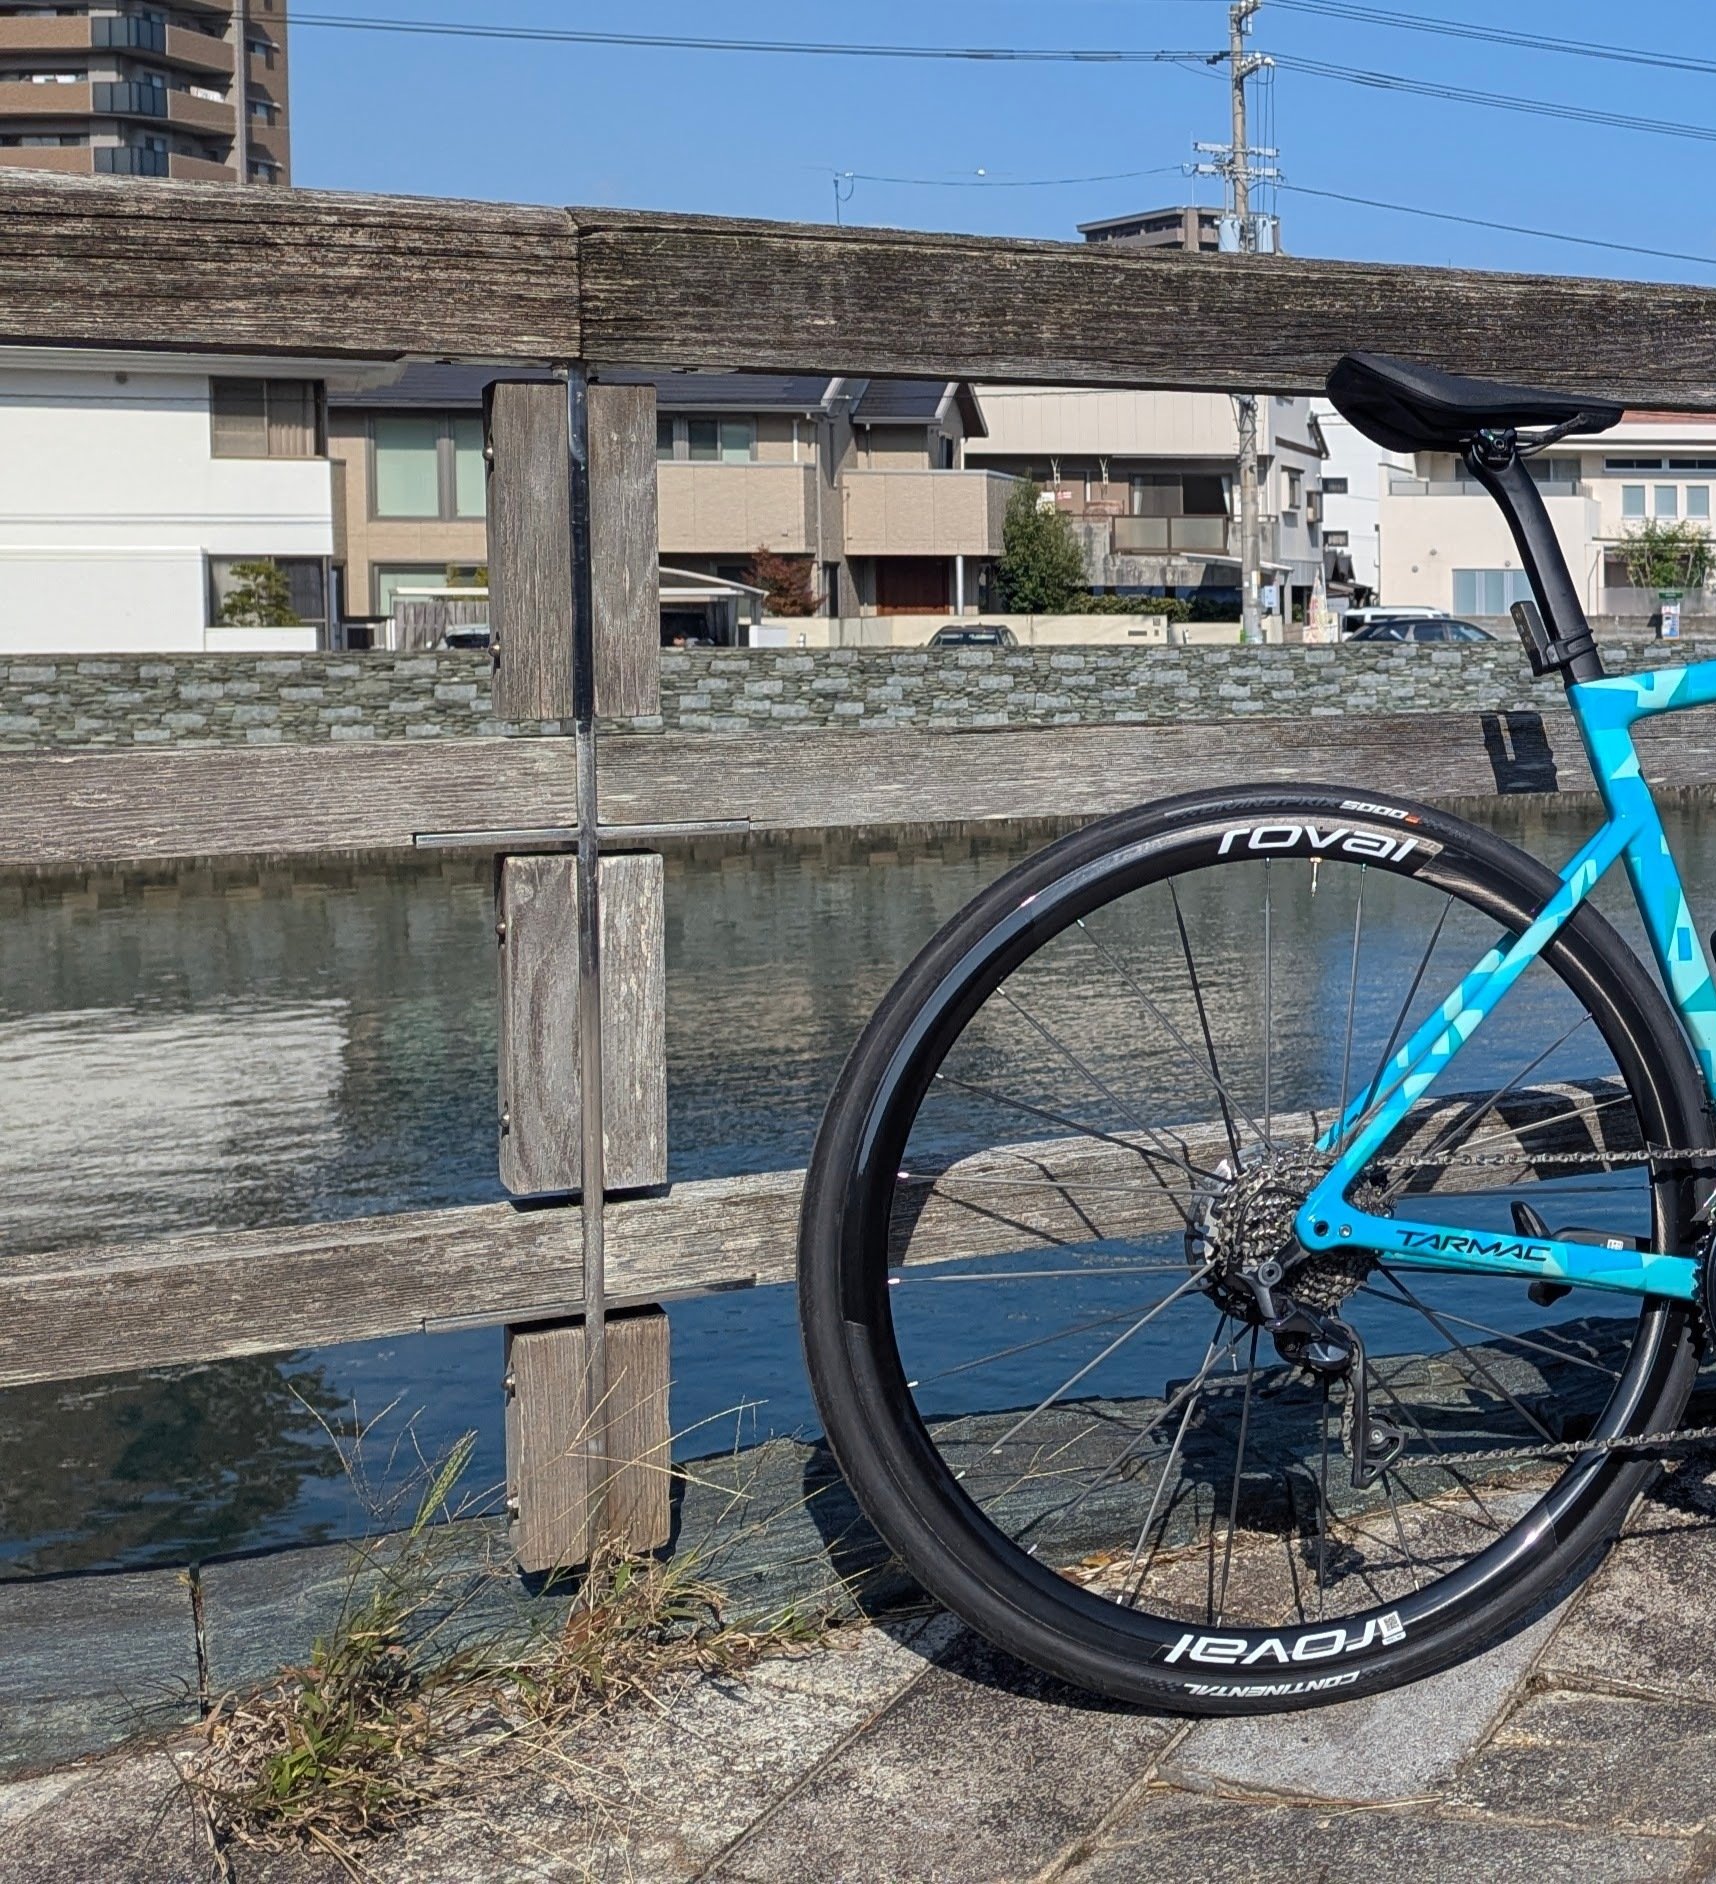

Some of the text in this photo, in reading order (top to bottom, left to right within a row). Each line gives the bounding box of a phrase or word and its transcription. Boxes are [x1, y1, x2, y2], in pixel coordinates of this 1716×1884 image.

[1339, 800, 1408, 819] 5000
[1217, 825, 1418, 862] roval
[1396, 1229, 1551, 1262] TARMAC
[1164, 1619, 1377, 1664] roval
[1184, 1670, 1361, 1698] CONTINENTAL
